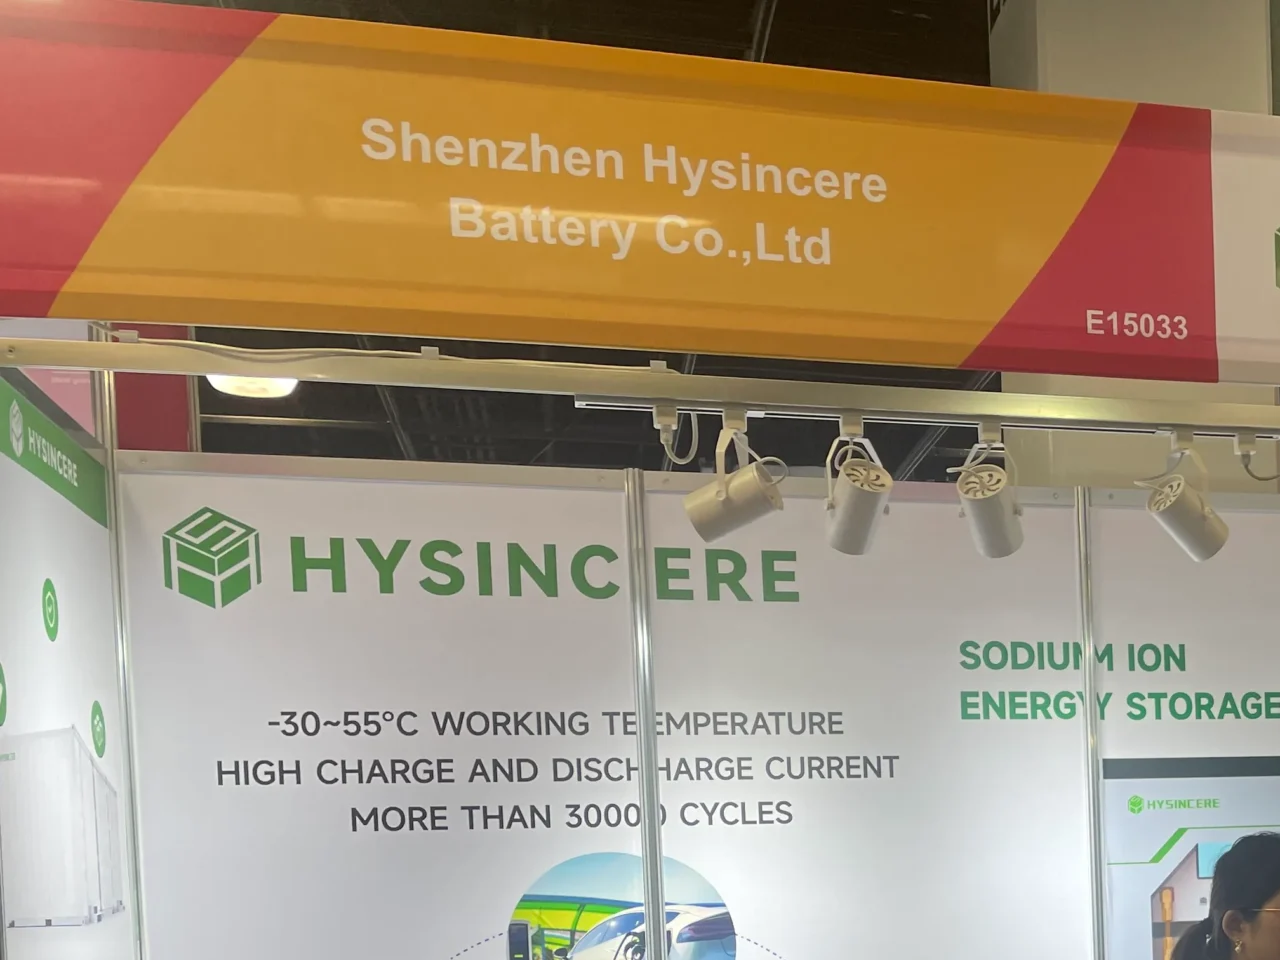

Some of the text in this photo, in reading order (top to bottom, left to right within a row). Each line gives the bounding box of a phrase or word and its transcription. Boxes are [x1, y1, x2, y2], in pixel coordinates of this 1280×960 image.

[361, 118, 888, 203] Shenzhen Hysincere
[449, 197, 832, 267] Battery Co.,Ltd
[1085, 309, 1189, 341] E15033
[28, 428, 78, 487] HYSINCERE
[290, 536, 801, 604] HYSINCERE
[959, 640, 1187, 672] SODIUM ION
[961, 691, 1113, 721] ENERGY
[432, 710, 590, 737] WORKING
[216, 754, 900, 788] HIGH CHARGE AND DISCHARGE CURRENT
[350, 805, 449, 833] MORE
[461, 804, 552, 830] THAN
[679, 800, 793, 827] CYCLES
[1146, 798, 1221, 811] HYSINCERE
